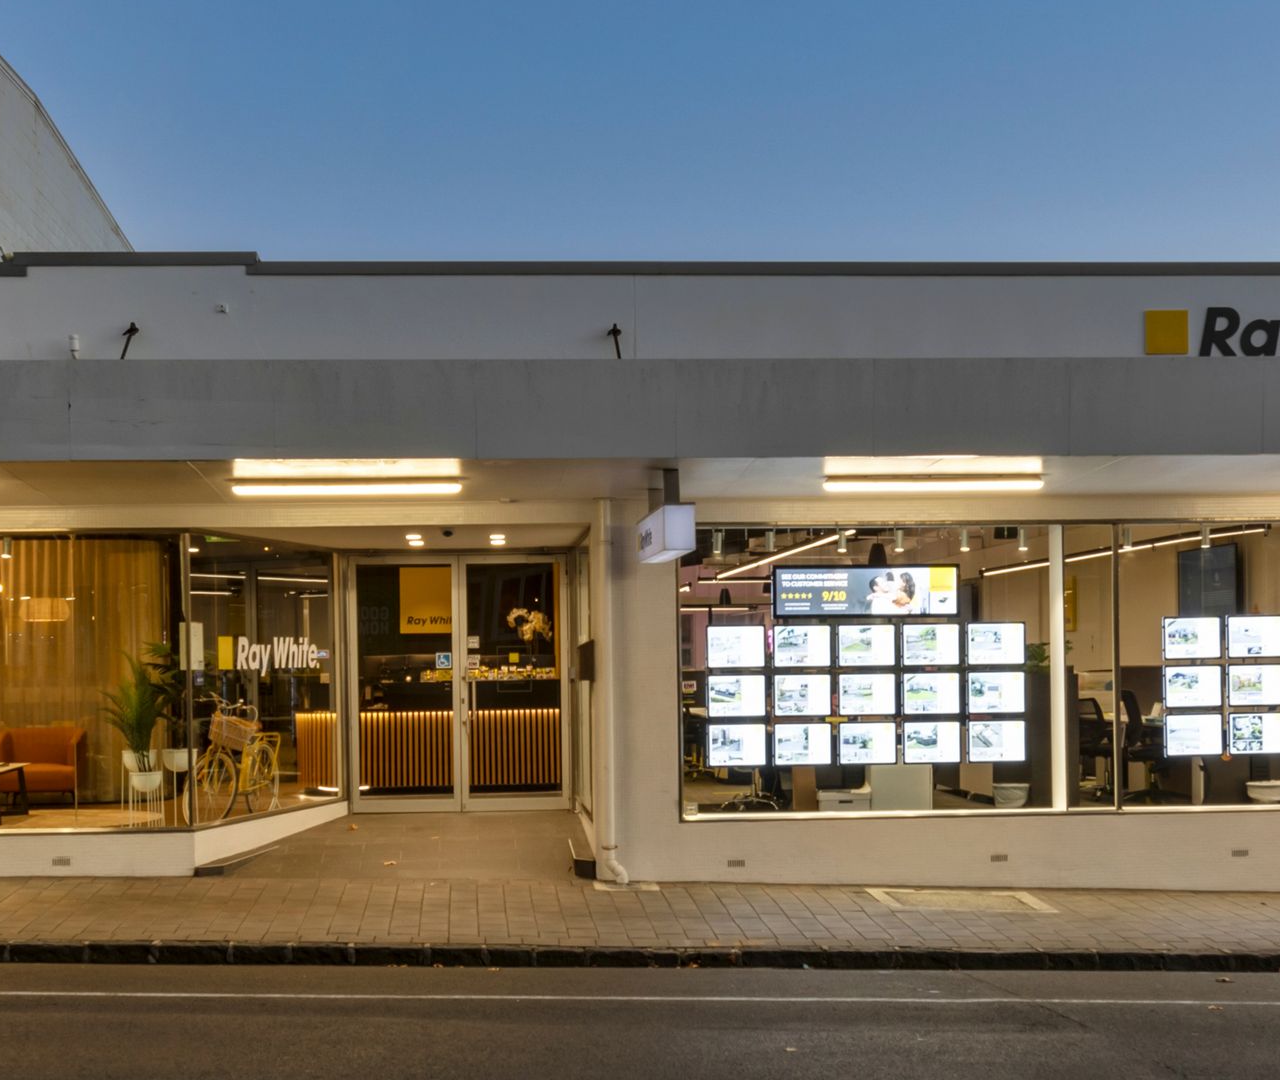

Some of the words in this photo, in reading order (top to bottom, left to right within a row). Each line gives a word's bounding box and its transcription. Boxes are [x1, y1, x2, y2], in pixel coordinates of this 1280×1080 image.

[822, 590, 846, 601] 9/10
[430, 615, 452, 624] Whit
[237, 636, 271, 677] Ray
